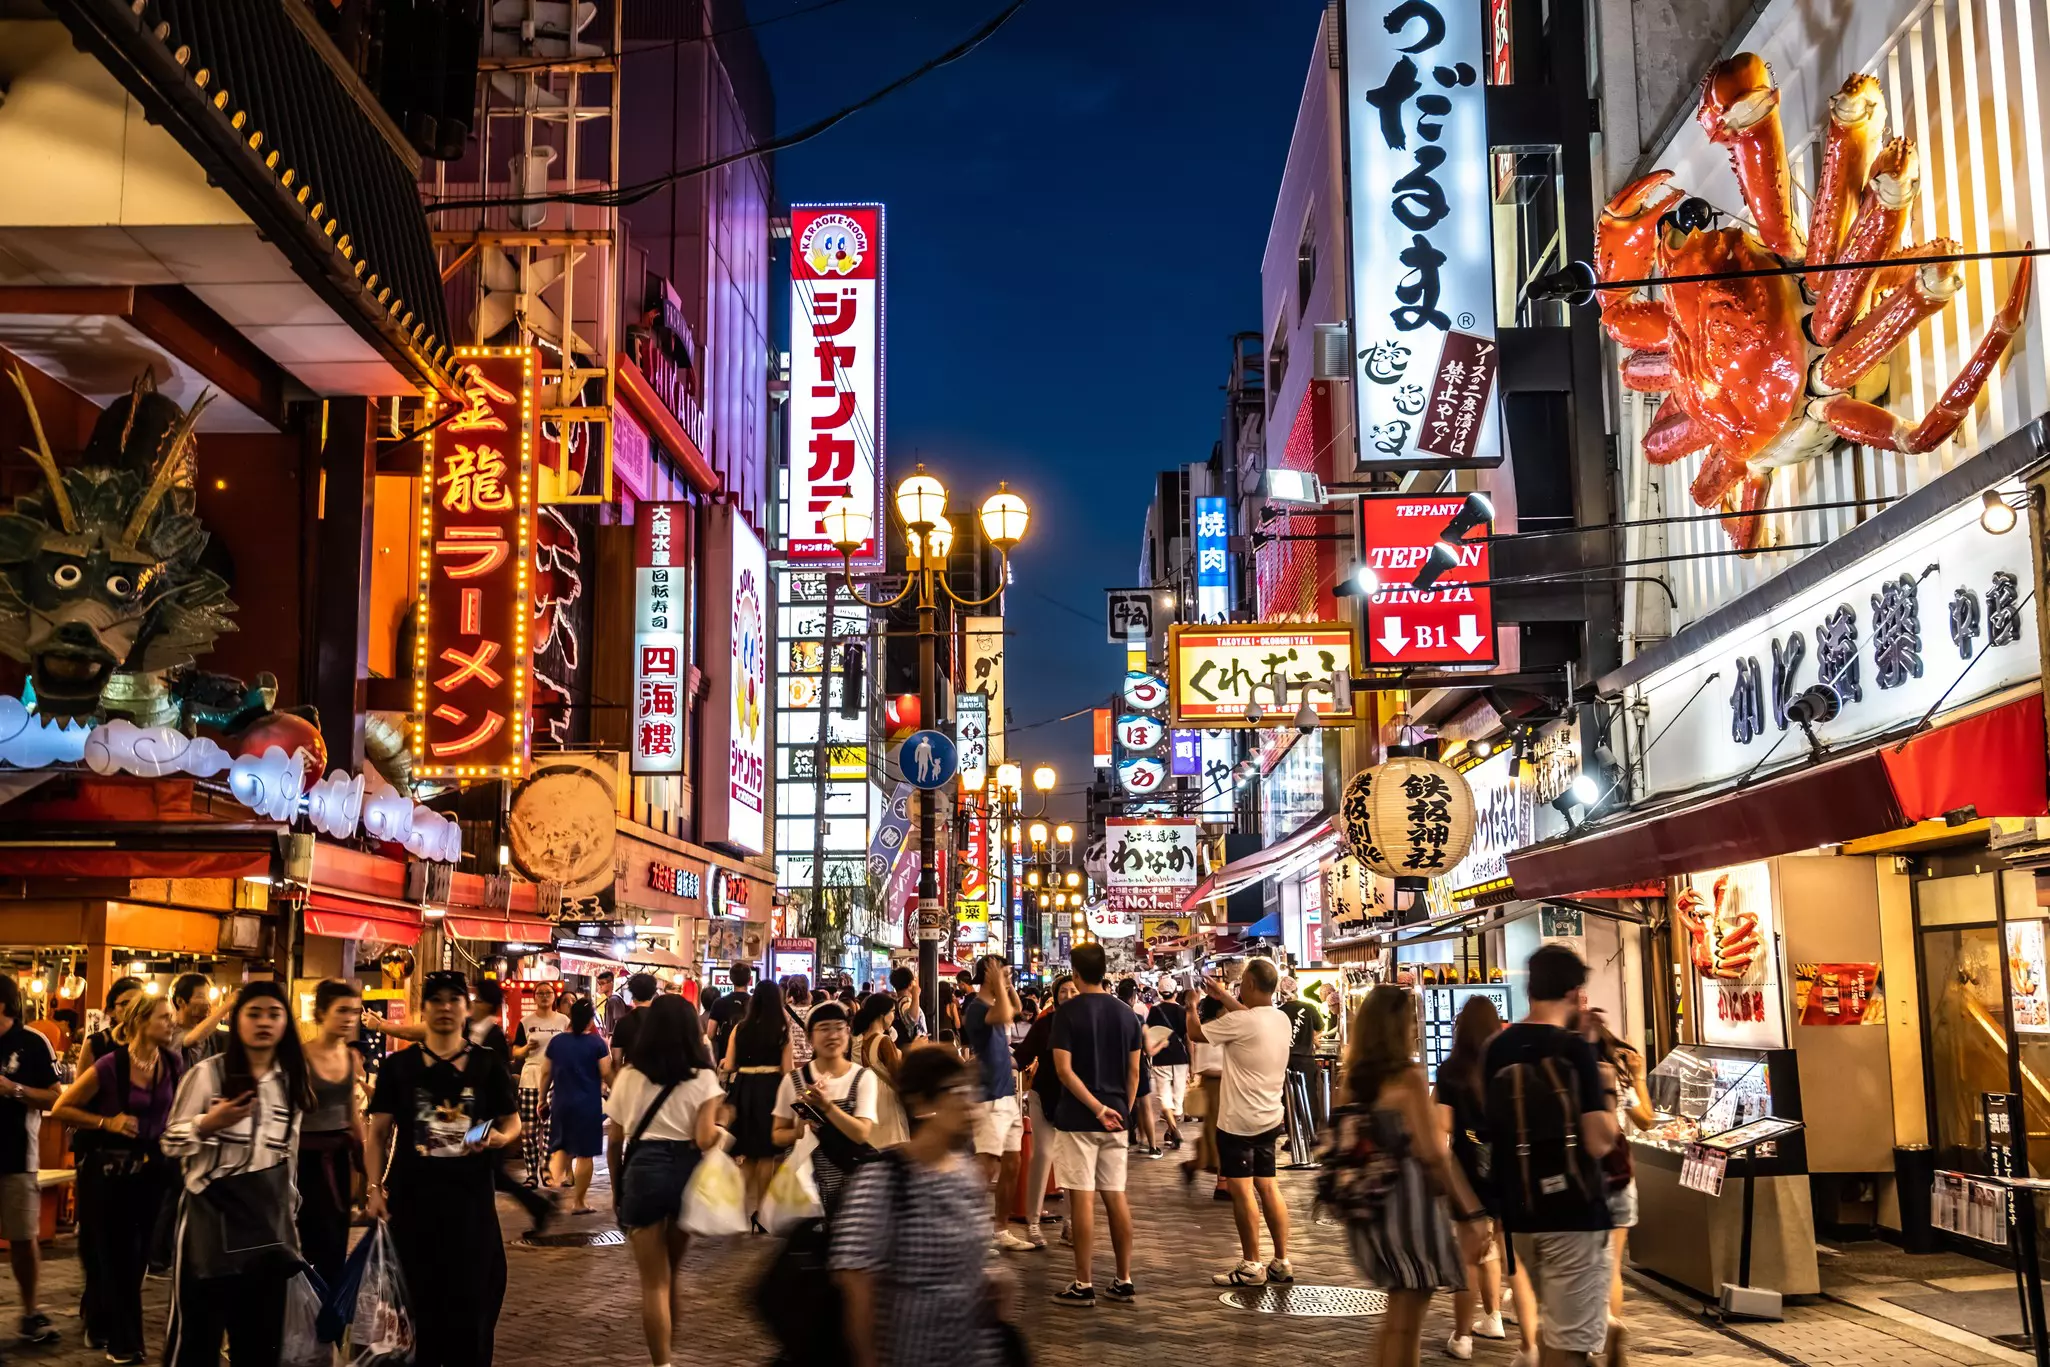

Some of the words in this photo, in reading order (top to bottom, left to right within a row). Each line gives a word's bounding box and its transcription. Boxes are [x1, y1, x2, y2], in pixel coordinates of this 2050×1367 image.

[431, 364, 516, 757] 金龍ラーメン
[652, 505, 671, 567] 大起水産
[1197, 511, 1227, 573] 焼肉
[651, 569, 669, 629] 回転寿司
[1414, 626, 1447, 648] B1
[1400, 772, 1453, 870] 鉄板神社
[1109, 841, 1194, 875] わなか
[1125, 895, 1157, 909] No.1
